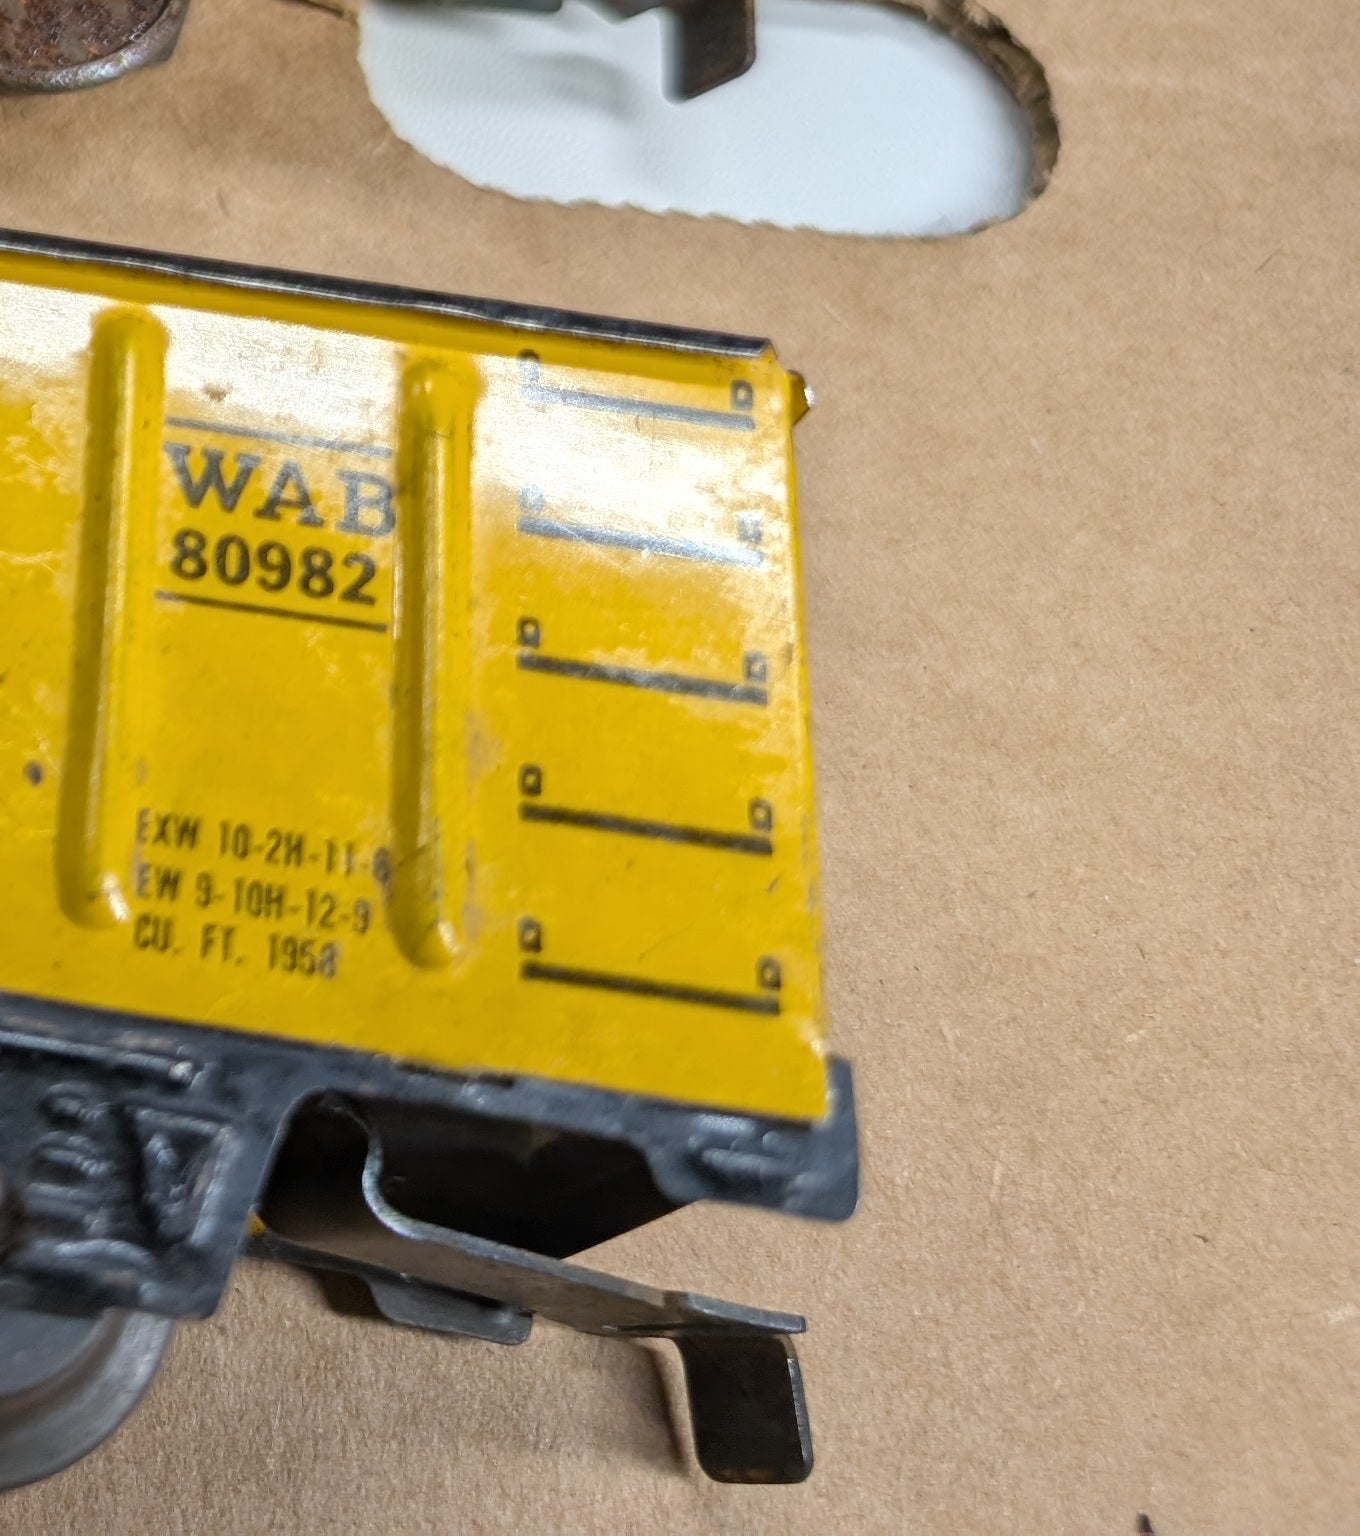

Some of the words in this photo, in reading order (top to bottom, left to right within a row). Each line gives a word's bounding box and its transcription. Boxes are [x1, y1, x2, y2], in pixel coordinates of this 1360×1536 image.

[163, 440, 397, 538] WAB
[171, 528, 377, 606] 80982
[136, 808, 201, 850] EXW
[135, 863, 182, 902] EW
[134, 914, 180, 955] CU.
[200, 923, 245, 965] FT.
[268, 933, 340, 979] 1958
